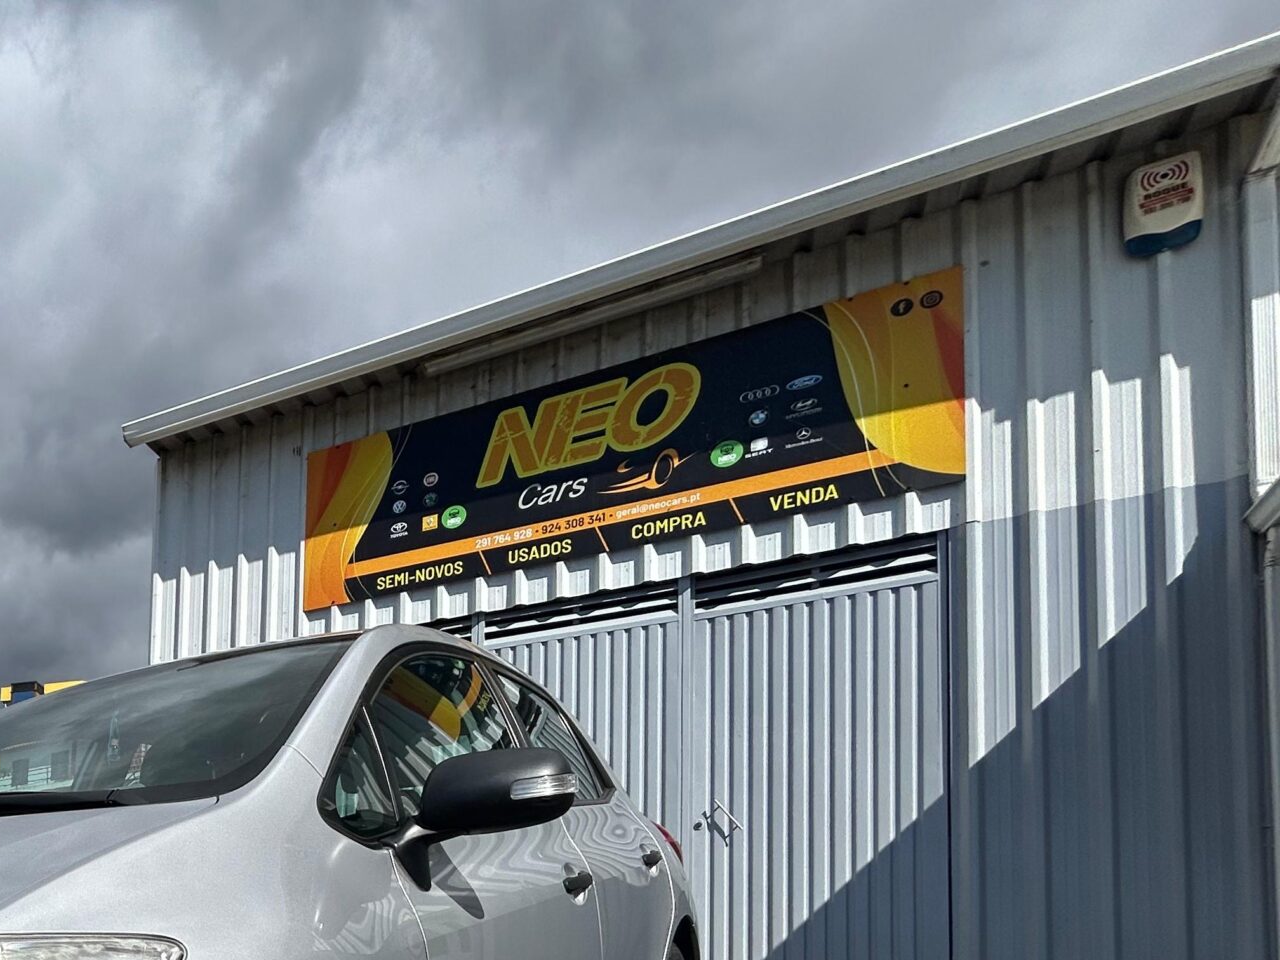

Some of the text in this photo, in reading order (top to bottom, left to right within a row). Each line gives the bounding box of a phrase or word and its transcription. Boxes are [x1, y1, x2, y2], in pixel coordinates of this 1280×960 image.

[476, 362, 702, 489] NEO
[744, 448, 774, 459] SEAT
[518, 477, 588, 510] Cars
[769, 483, 839, 512] VENDA
[390, 531, 408, 539] TOYOTA
[475, 538, 491, 549] 291
[513, 528, 533, 542] 928
[541, 522, 561, 535] 924
[564, 517, 585, 530] 308
[587, 512, 606, 526] 341
[615, 493, 701, 519] geral@neocars.pt
[631, 511, 707, 540] COMPRA
[508, 539, 572, 564] USADOS
[376, 560, 464, 591] SEMI-NOVOS
